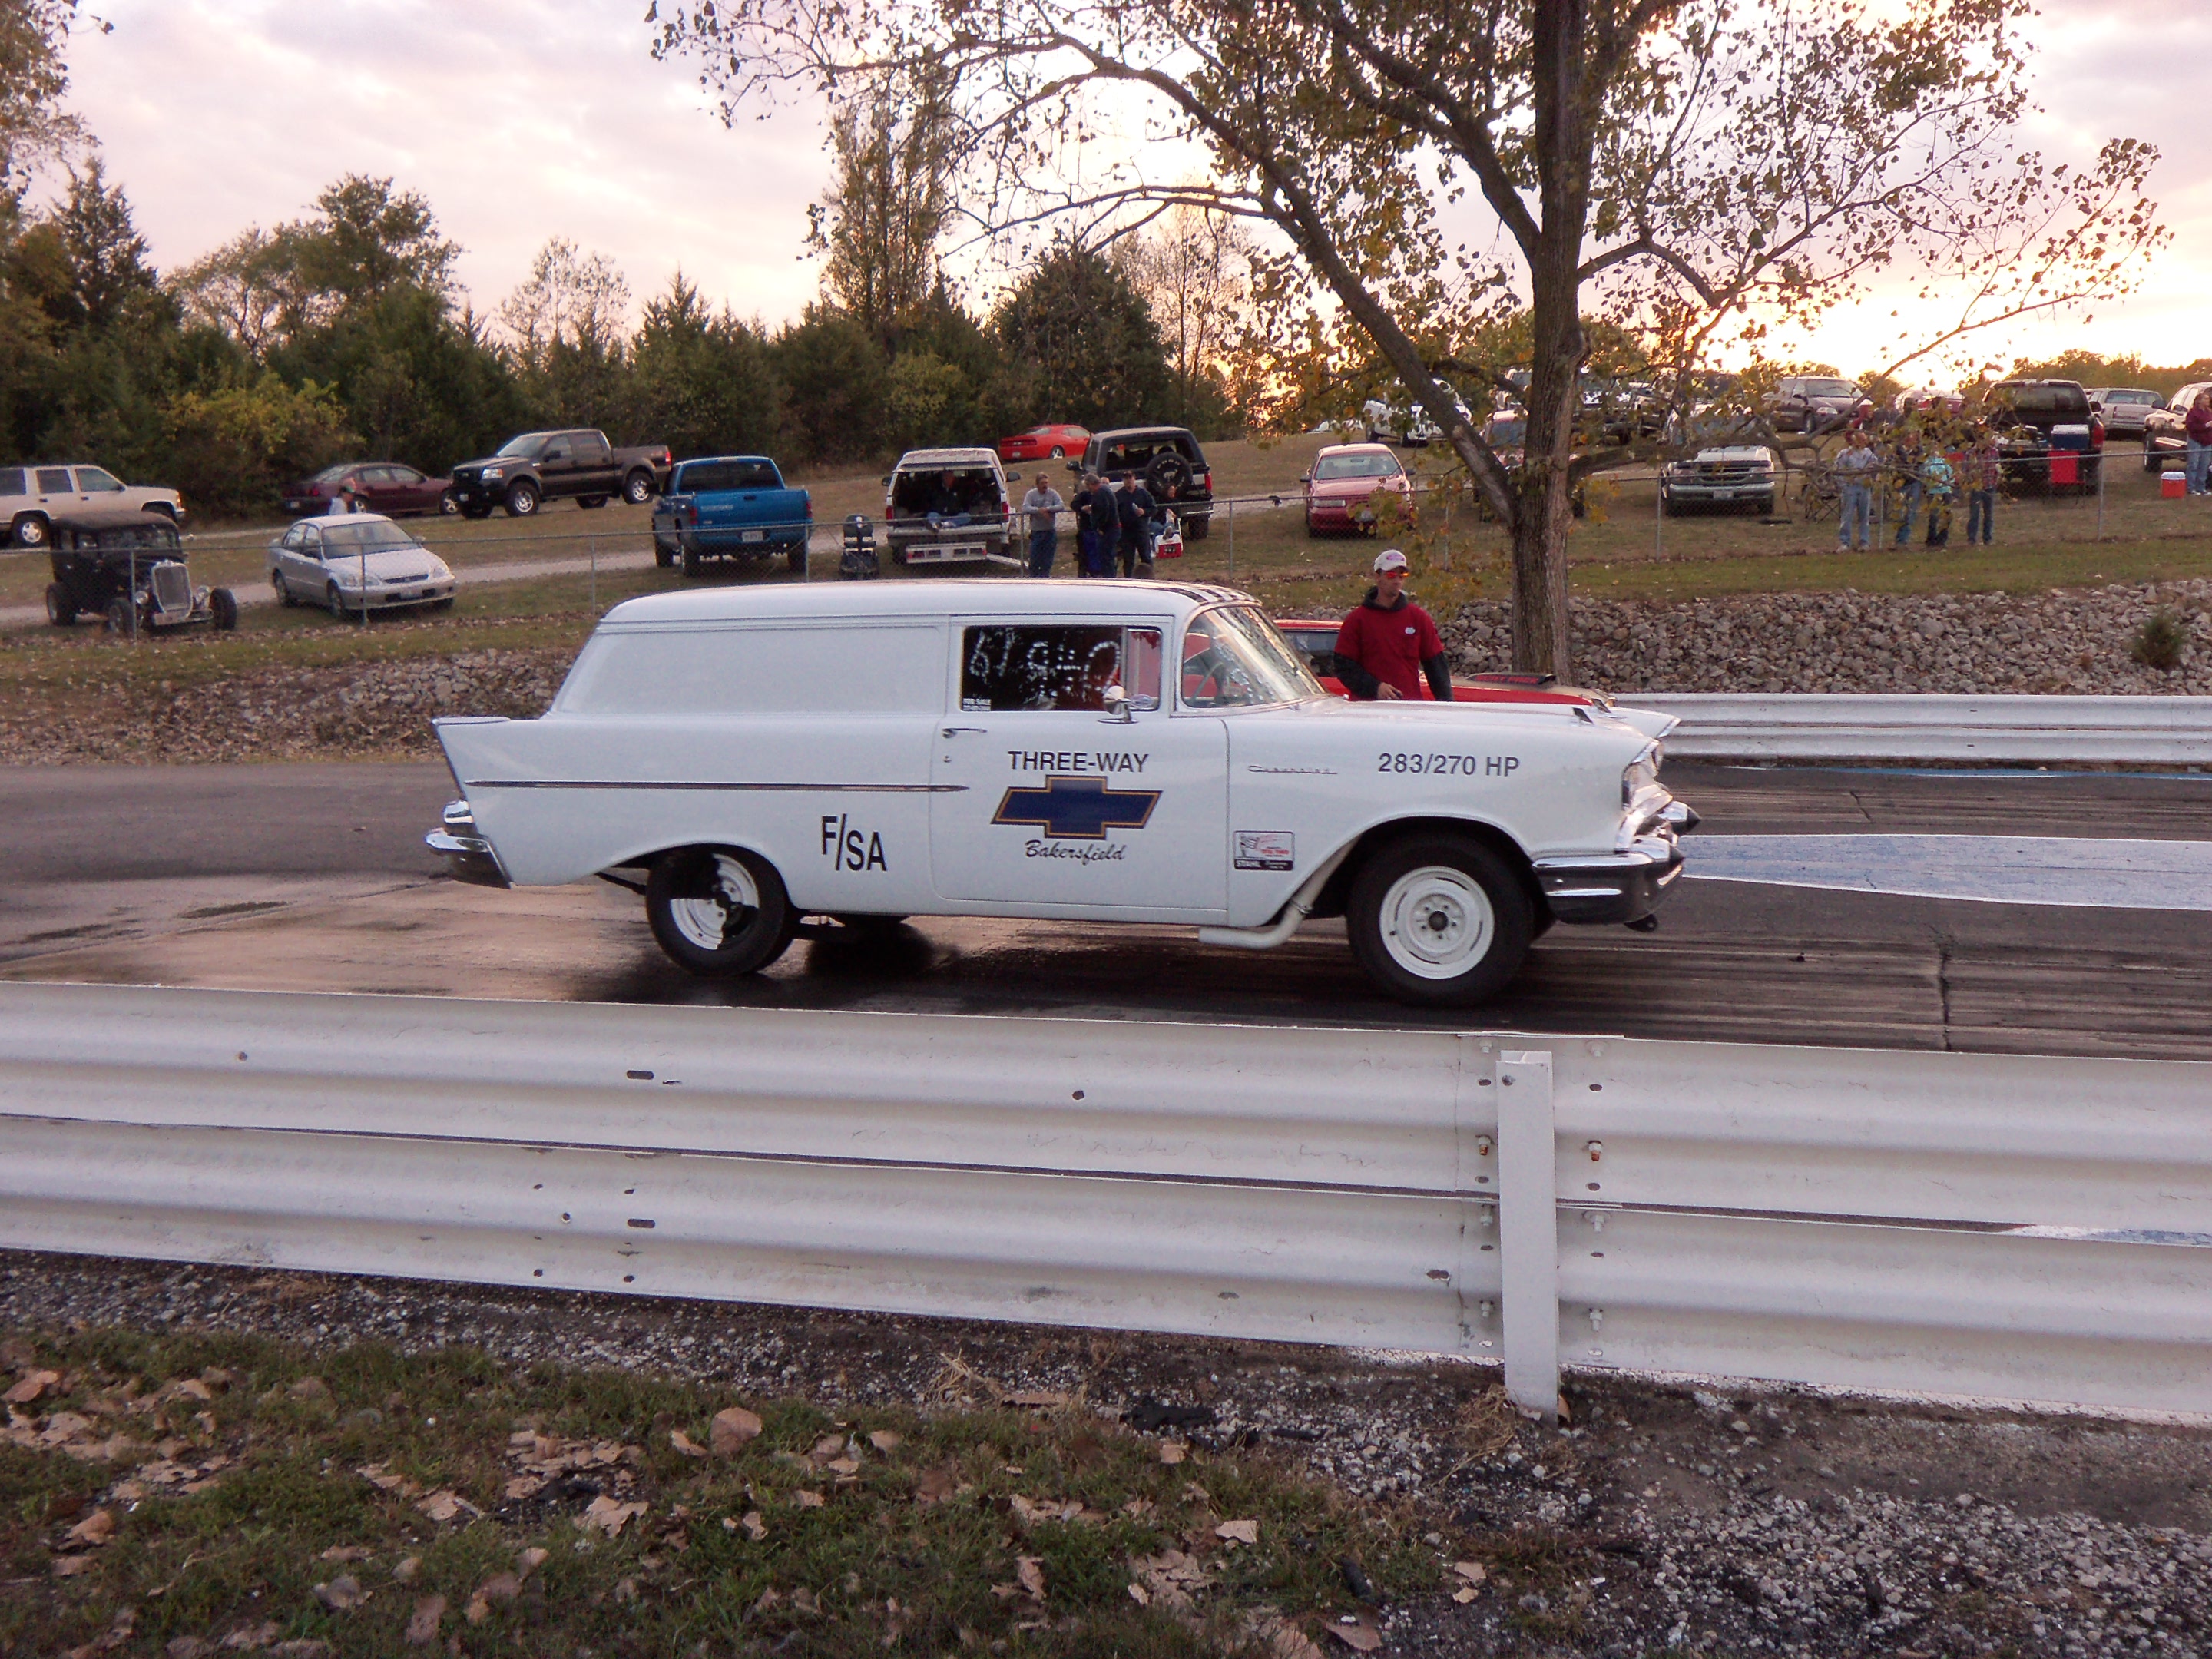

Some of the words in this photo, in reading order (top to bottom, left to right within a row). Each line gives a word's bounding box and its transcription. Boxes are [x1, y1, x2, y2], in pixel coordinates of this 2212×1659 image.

[1008, 750, 1149, 773] THREE-WAY
[1378, 753, 1475, 776] 283/270
[1485, 757, 1520, 777] HP
[821, 813, 888, 871] F/SA
[1025, 839, 1127, 866] Bakersfield
